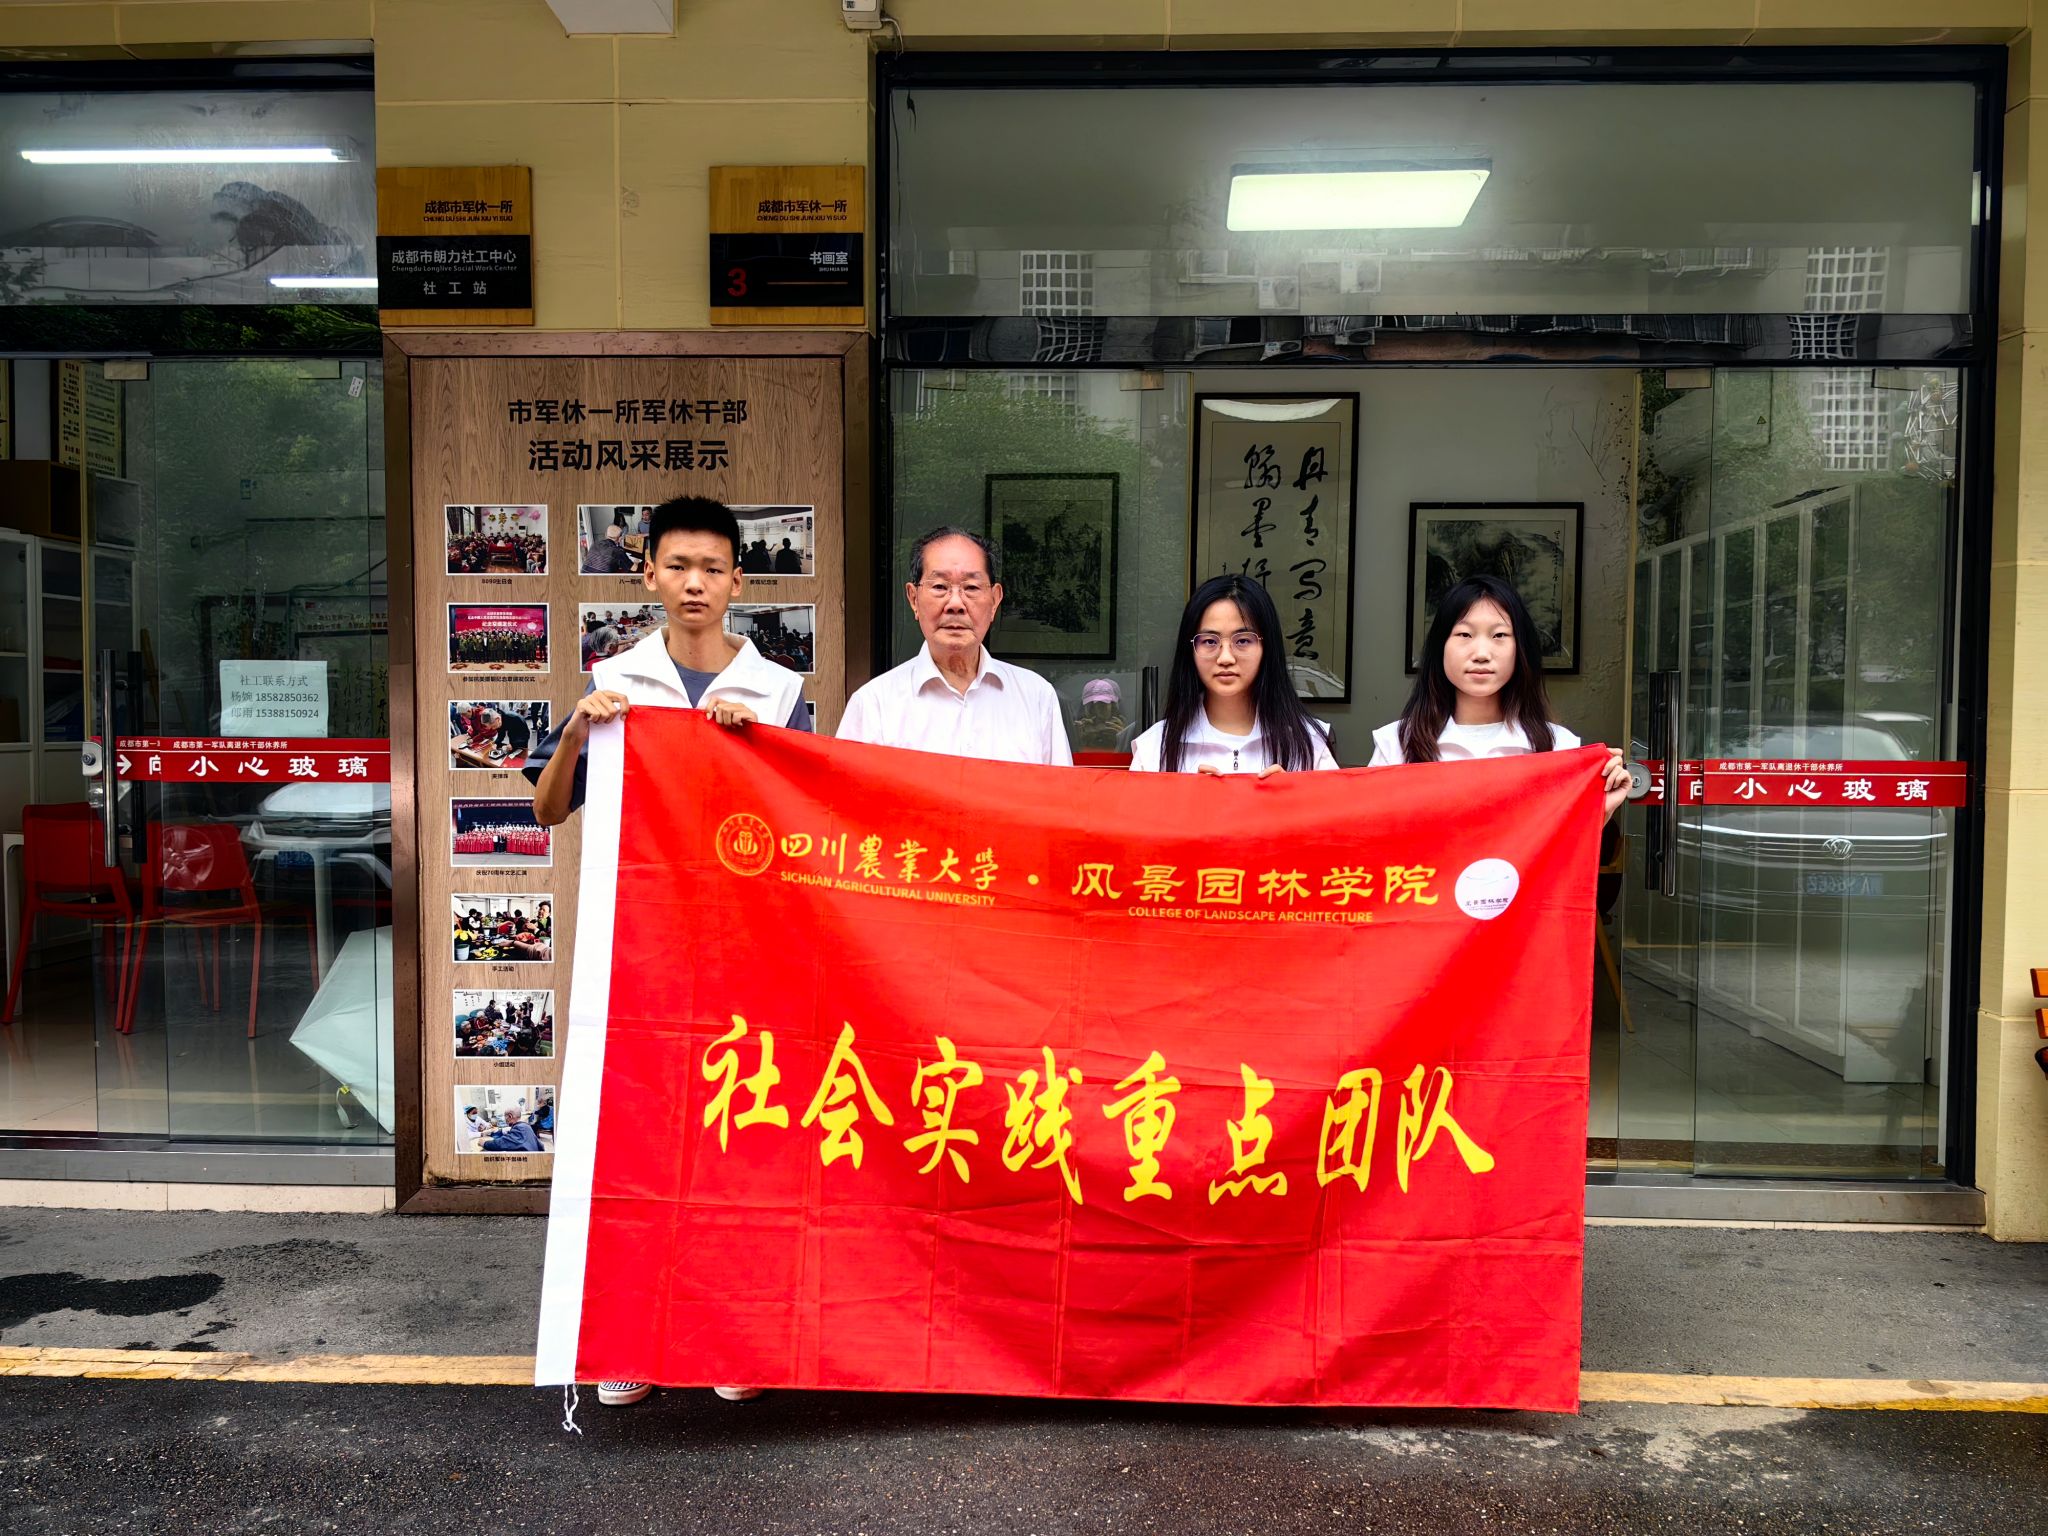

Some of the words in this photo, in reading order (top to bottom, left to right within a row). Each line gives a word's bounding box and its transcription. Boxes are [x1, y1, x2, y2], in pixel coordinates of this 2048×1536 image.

[424, 200, 513, 214] 成都市军休一所
[758, 200, 848, 214] 成都市军休一所
[391, 249, 517, 264] 成都市朗力社工中心
[809, 251, 849, 265] 书画室
[392, 265, 422, 274] Chengdu
[423, 265, 452, 274] Longlive
[423, 281, 487, 295] 社工站
[727, 268, 748, 297] 3
[508, 399, 748, 426] 市军休一所军休干部
[528, 438, 730, 472] 活动风采展示
[239, 674, 309, 687] 社工联系方式
[256, 692, 319, 703] 18582850362
[256, 708, 319, 718] 15388150924
[172, 741, 288, 750] 成都市第一军队离退休干部休养所
[187, 755, 369, 778] 小心玻璃
[1718, 762, 1844, 772] 成都市第一军队离退休干部休养所
[1733, 777, 1931, 801] 小心玻璃
[780, 870, 832, 888] SICHUAN
[834, 878, 923, 901] AGRICULTURAL
[925, 890, 996, 907] UNIVERSITY
[1071, 862, 1440, 906] 风景园林学院
[1128, 906, 1183, 919] COLLEGE
[1185, 908, 1201, 919] OF
[1203, 909, 1276, 921] LANDSCAPE
[1278, 910, 1374, 923] ARCHITECTURE
[701, 1013, 1495, 1206] 社会实践重点团队
